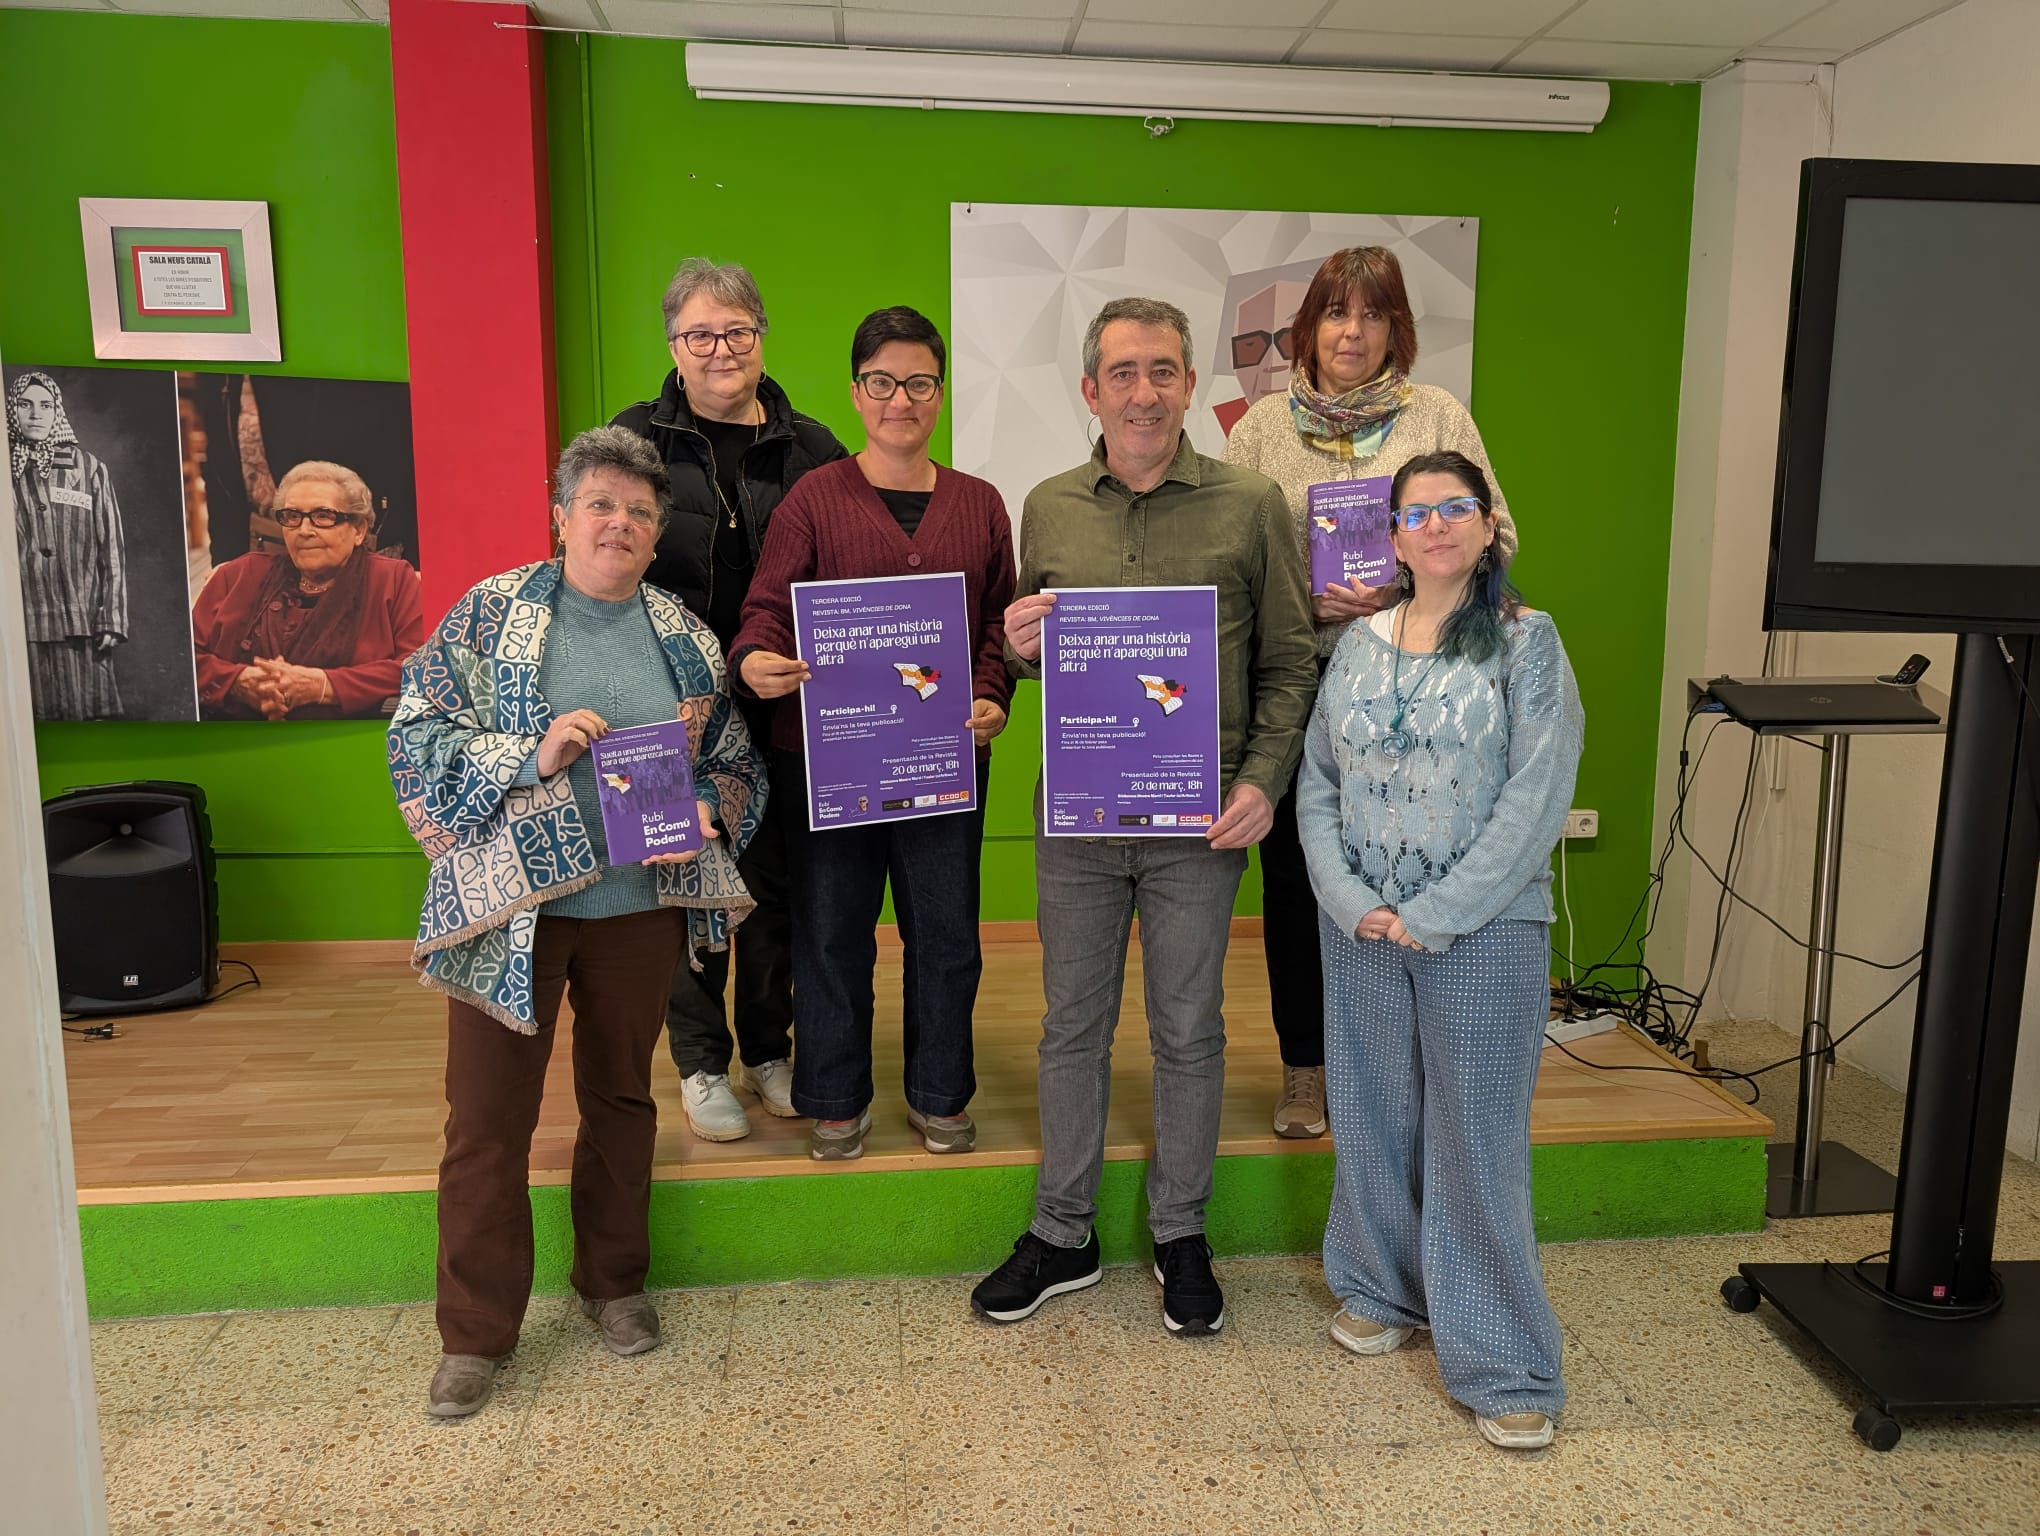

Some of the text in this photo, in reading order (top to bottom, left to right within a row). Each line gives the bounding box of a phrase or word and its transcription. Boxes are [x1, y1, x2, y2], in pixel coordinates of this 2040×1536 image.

[149, 256, 166, 264] SALA
[186, 256, 211, 265] CATALÀ
[1314, 504, 1328, 512] para
[1343, 551, 1363, 560] Rubí
[1344, 557, 1386, 571] En Comú
[840, 595, 862, 603] EDICIÓ
[813, 618, 943, 640] Deixa anar una història
[815, 633, 940, 655] perquè n'aparegui una
[1059, 631, 1191, 646] Deixa anar una història
[816, 653, 844, 666] altra
[1059, 646, 1187, 661] perquè n'aparegui una
[1060, 661, 1087, 672] altra
[820, 705, 876, 717] Participa-hi!
[1060, 716, 1117, 725] Participa-hi!
[600, 743, 662, 760] Suelta una historia
[601, 748, 679, 768] para que aparezca otra
[882, 755, 918, 764] Presentació
[892, 760, 959, 775] 20 de març, 18h
[1131, 780, 1203, 792] 20 de març, 18h
[642, 810, 664, 824] Rubí
[644, 818, 691, 836] En Comú
[646, 833, 686, 848] Podem
